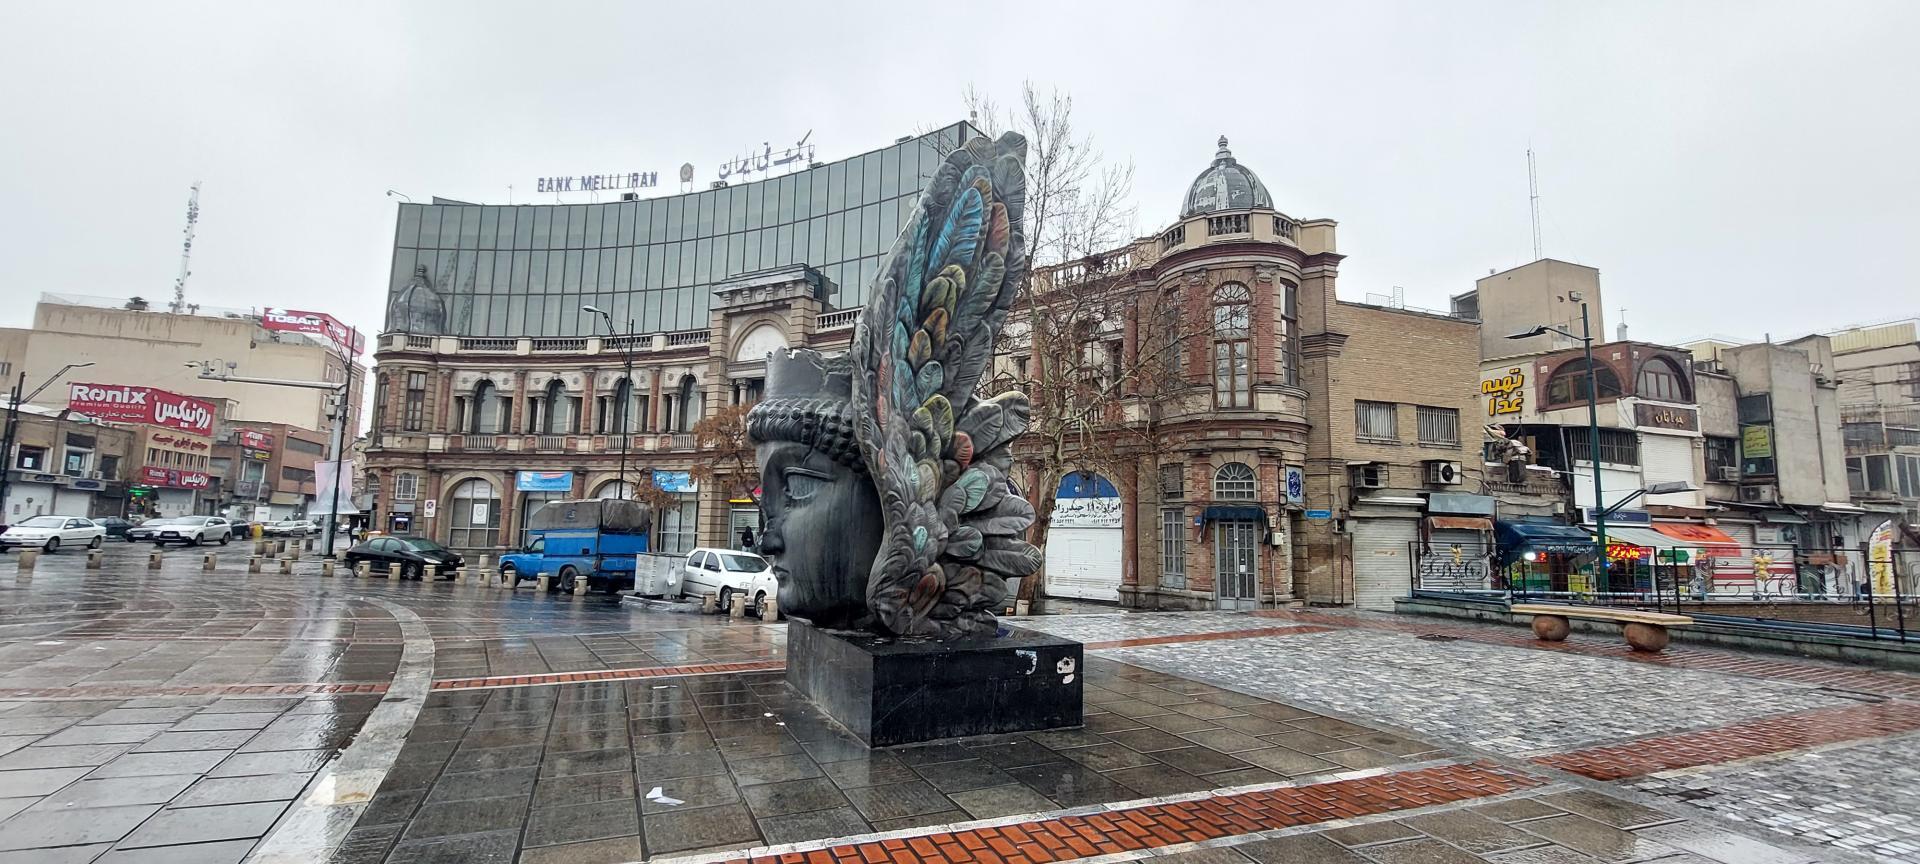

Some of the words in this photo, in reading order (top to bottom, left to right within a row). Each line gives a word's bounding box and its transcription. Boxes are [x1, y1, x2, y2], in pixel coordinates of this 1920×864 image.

[757, 142, 771, 171] ملی
[773, 129, 813, 166] بانک
[719, 150, 755, 179] ایران
[537, 176, 572, 192] BANK
[580, 174, 621, 191] MELLI
[626, 171, 658, 188] IRAN
[266, 314, 321, 326] TOSAN
[1481, 368, 1524, 396] تهیه
[71, 385, 147, 405] Ronix
[71, 400, 110, 408] Premium
[112, 403, 147, 411] Quality
[1488, 391, 1524, 416] غذا
[154, 400, 211, 430] رونیکس
[181, 473, 208, 486] رونیکس
[1102, 501, 1121, 514] ابزار
